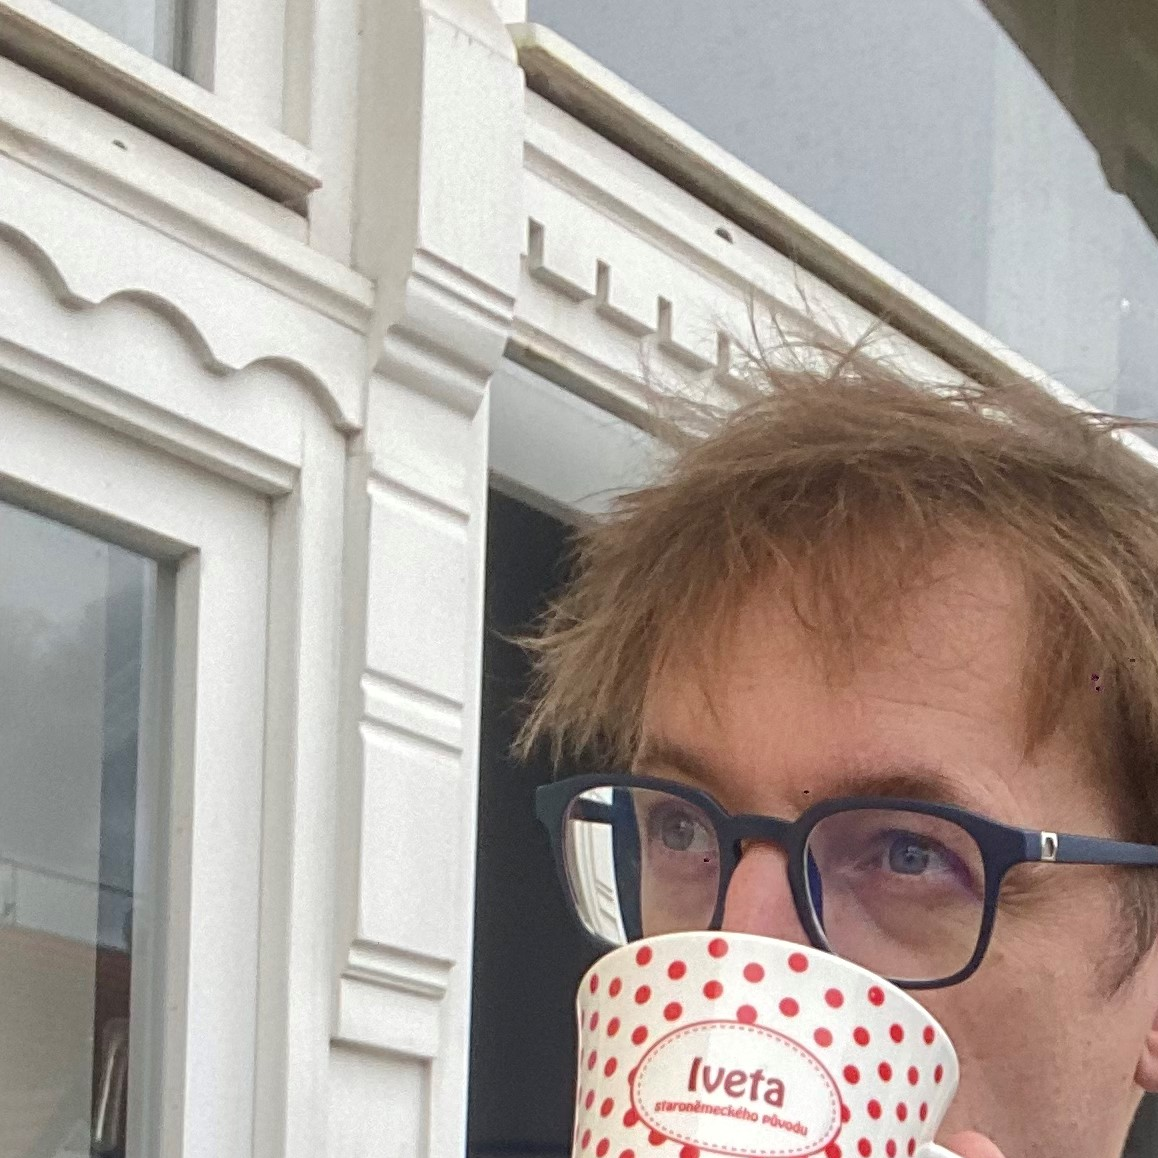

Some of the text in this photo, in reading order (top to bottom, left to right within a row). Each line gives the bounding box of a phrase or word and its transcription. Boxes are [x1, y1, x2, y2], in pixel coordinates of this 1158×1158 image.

[688, 1057, 785, 1108] Iveta
[654, 1100, 808, 1136] staroněmeckého původu
